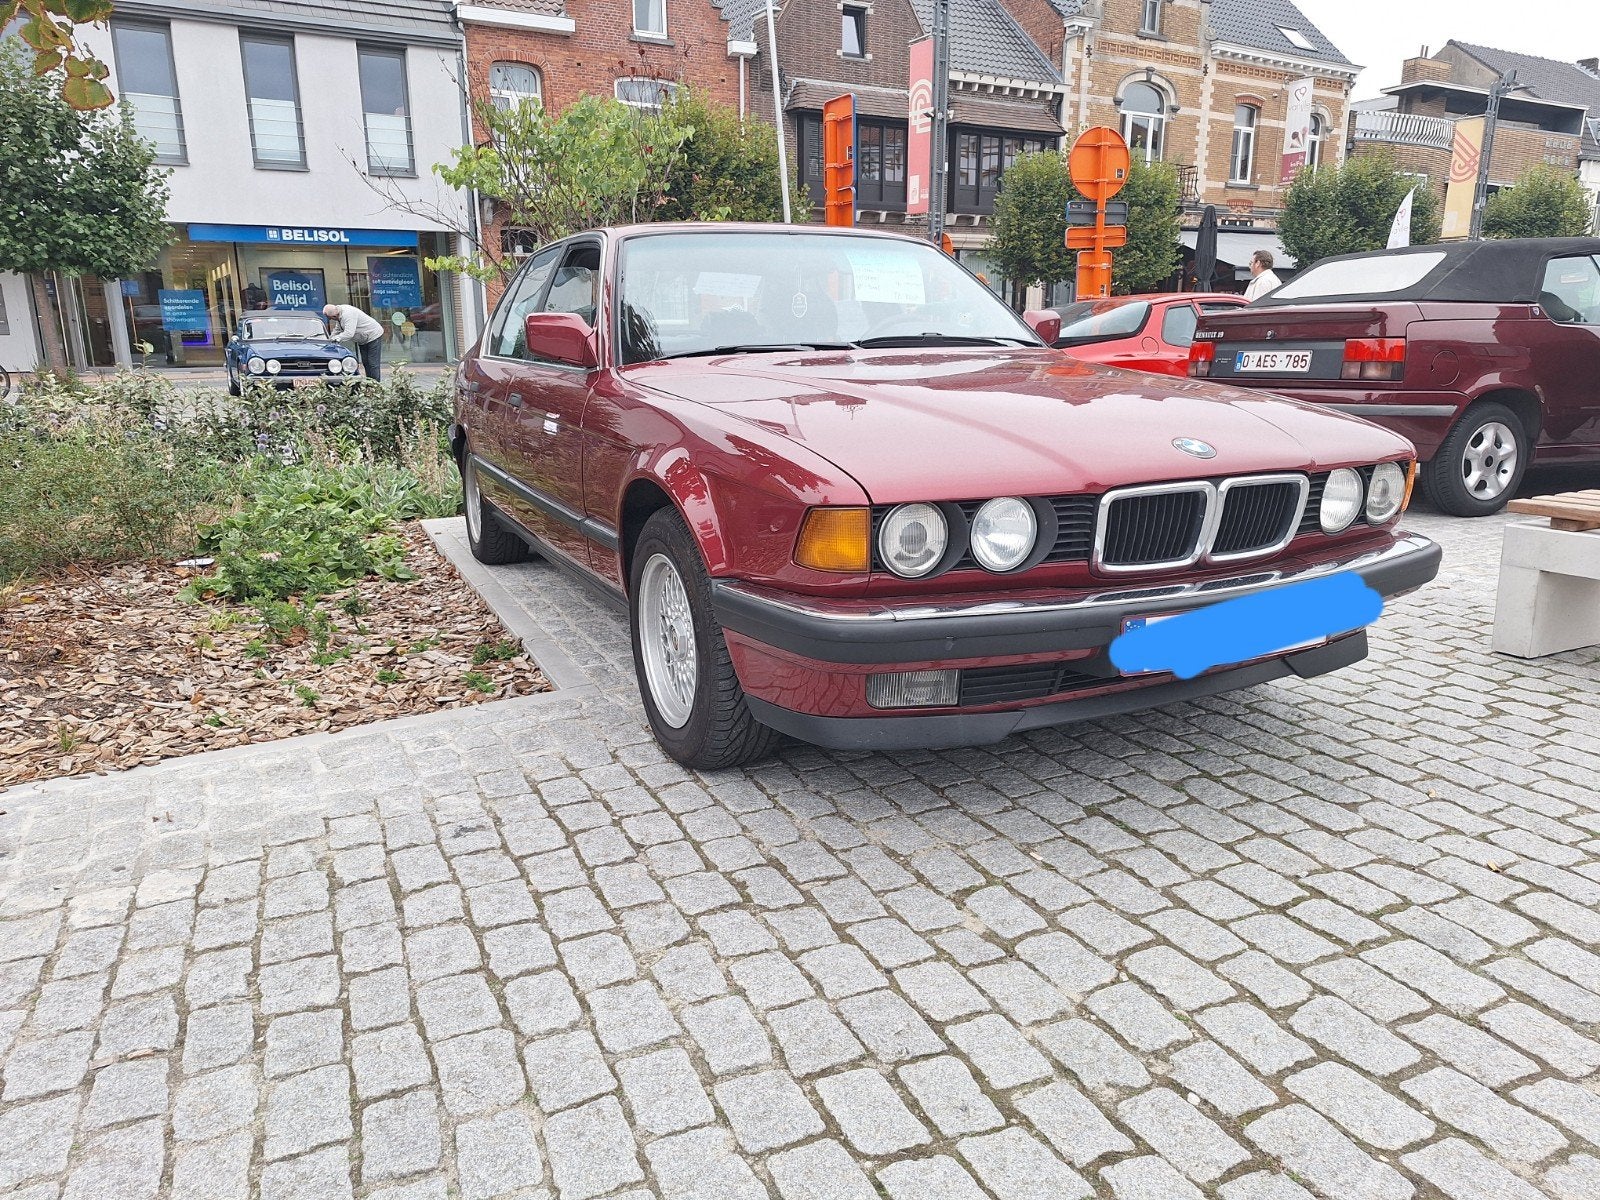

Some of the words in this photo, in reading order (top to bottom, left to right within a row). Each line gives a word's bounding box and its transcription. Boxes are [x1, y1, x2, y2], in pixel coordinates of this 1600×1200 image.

[281, 229, 350, 242] BELISOL
[273, 279, 317, 291] Belisol.
[275, 293, 307, 307] Altijd
[1195, 331, 1217, 339] RENAULT
